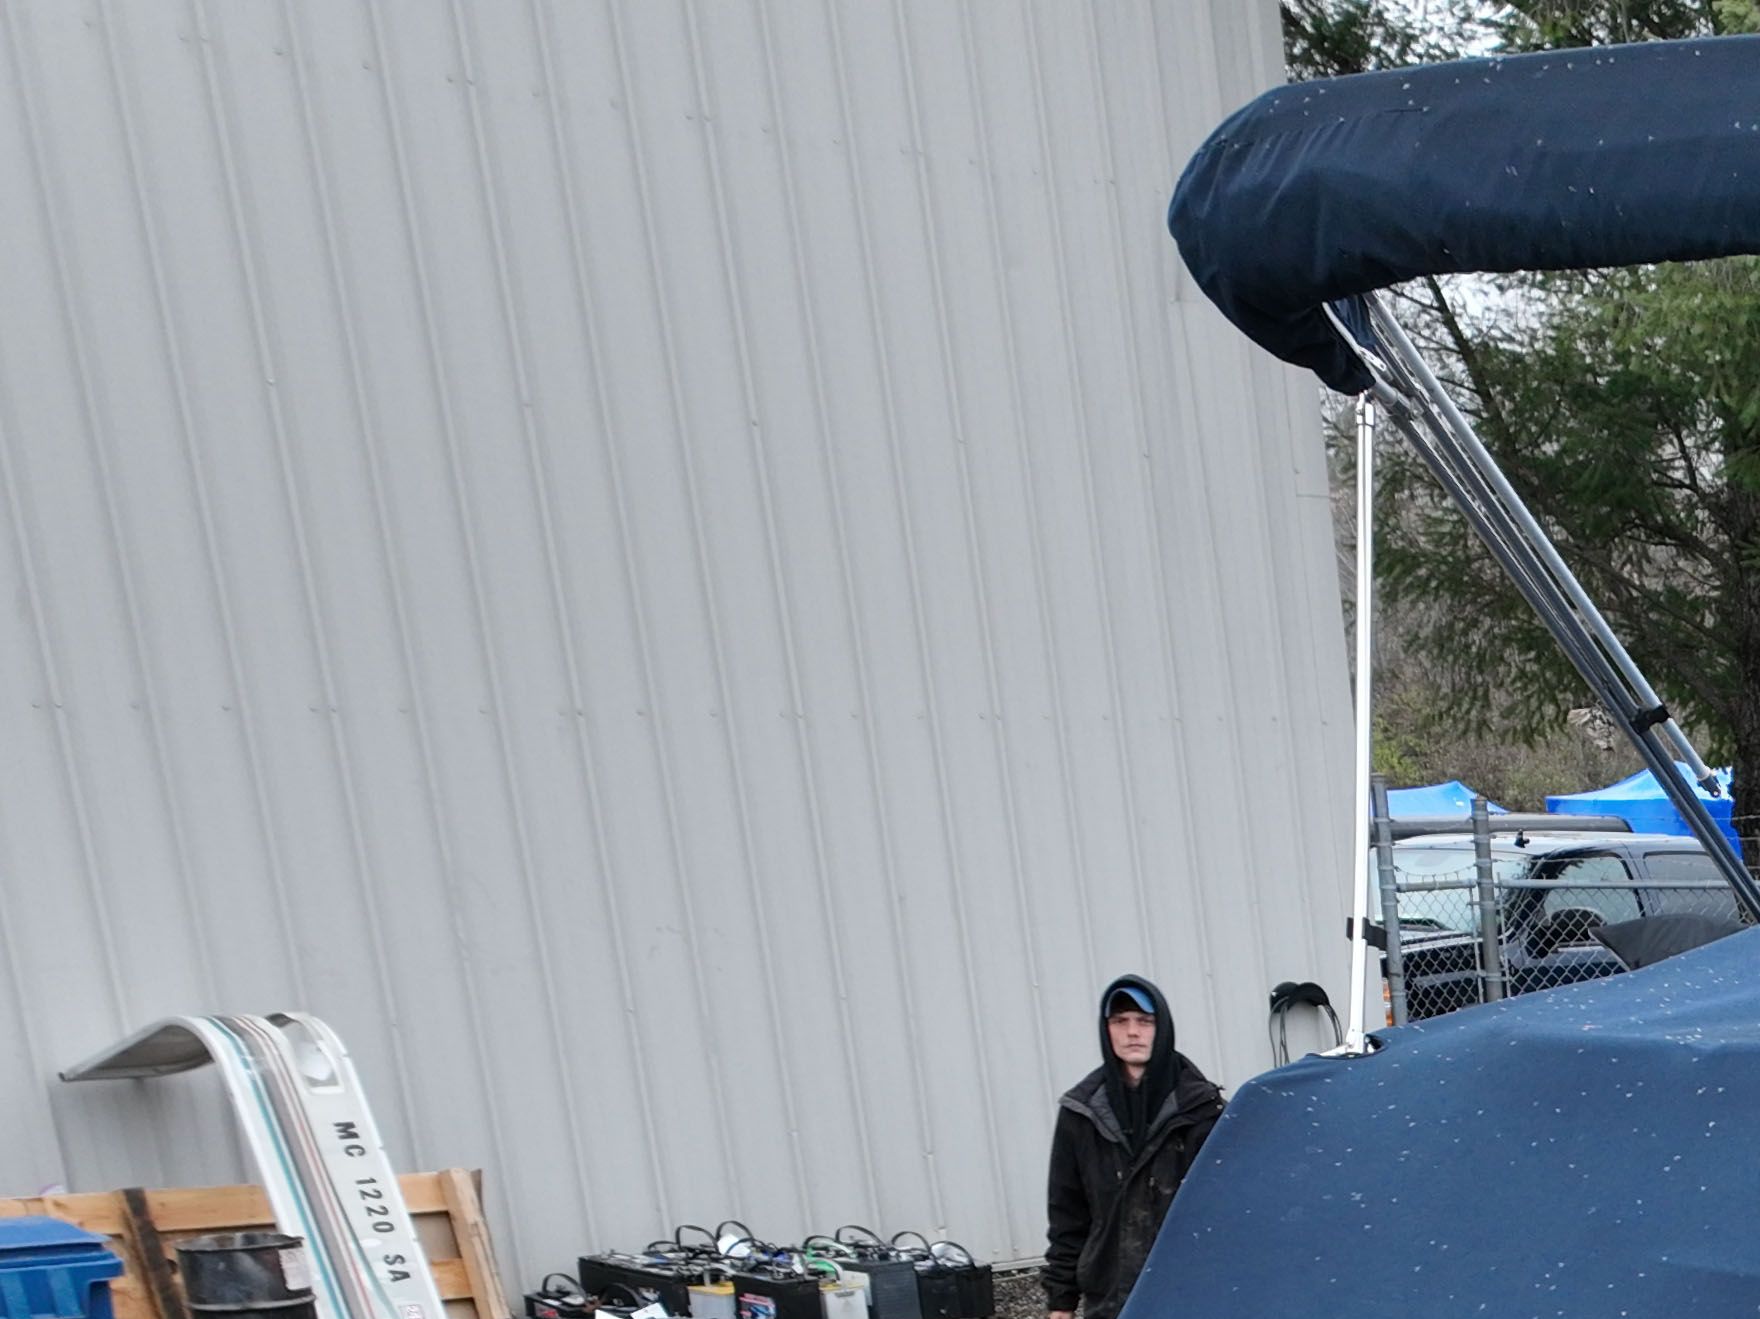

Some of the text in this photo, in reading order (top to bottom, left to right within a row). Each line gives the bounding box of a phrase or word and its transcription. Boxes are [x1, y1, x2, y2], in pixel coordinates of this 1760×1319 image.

[333, 1121, 411, 1283] MC 1220 SA
